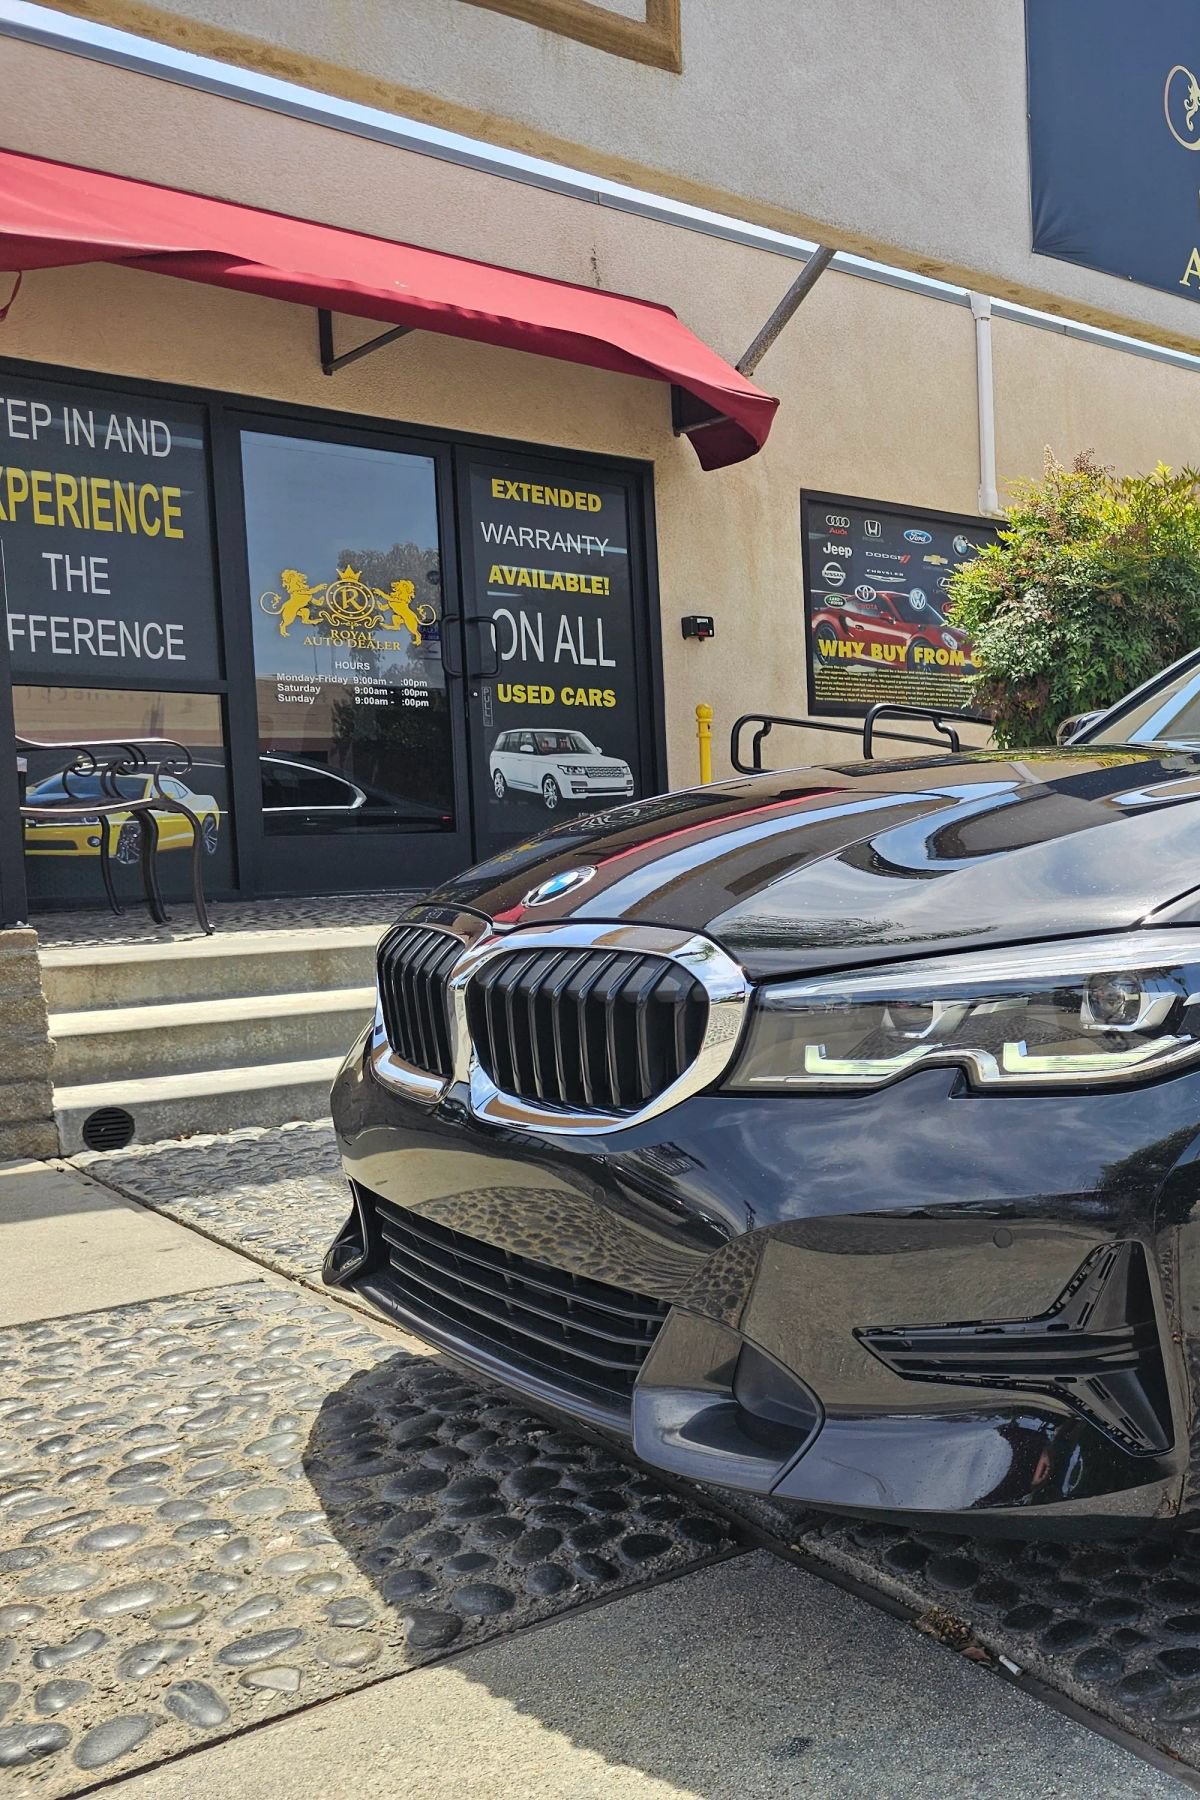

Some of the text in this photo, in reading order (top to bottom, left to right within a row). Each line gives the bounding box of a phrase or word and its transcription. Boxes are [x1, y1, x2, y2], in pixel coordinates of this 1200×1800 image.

[0, 397, 172, 458] EP IN AND
[491, 478, 602, 513] EXTENDED
[480, 521, 609, 557] WARRANTY
[822, 541, 853, 558] Jeep
[42, 552, 111, 595] THE
[488, 564, 610, 596] AVAILABLE!
[340, 588, 363, 611] R
[303, 636, 401, 651] AUTO DEALER
[330, 629, 376, 641] ROYAL
[490, 608, 617, 667] ON ALL
[818, 639, 865, 658] WHY
[870, 643, 909, 663] BUY
[914, 646, 966, 667] FROM
[334, 660, 371, 671] HOURS
[276, 673, 348, 685] Monday-Friday
[353, 676, 387, 686] 9:00am
[277, 683, 321, 695] Saturday
[354, 686, 388, 696] 9:00am
[278, 694, 315, 705] Sunday
[355, 696, 388, 706] 9:00am
[497, 683, 617, 708] USED CARS
